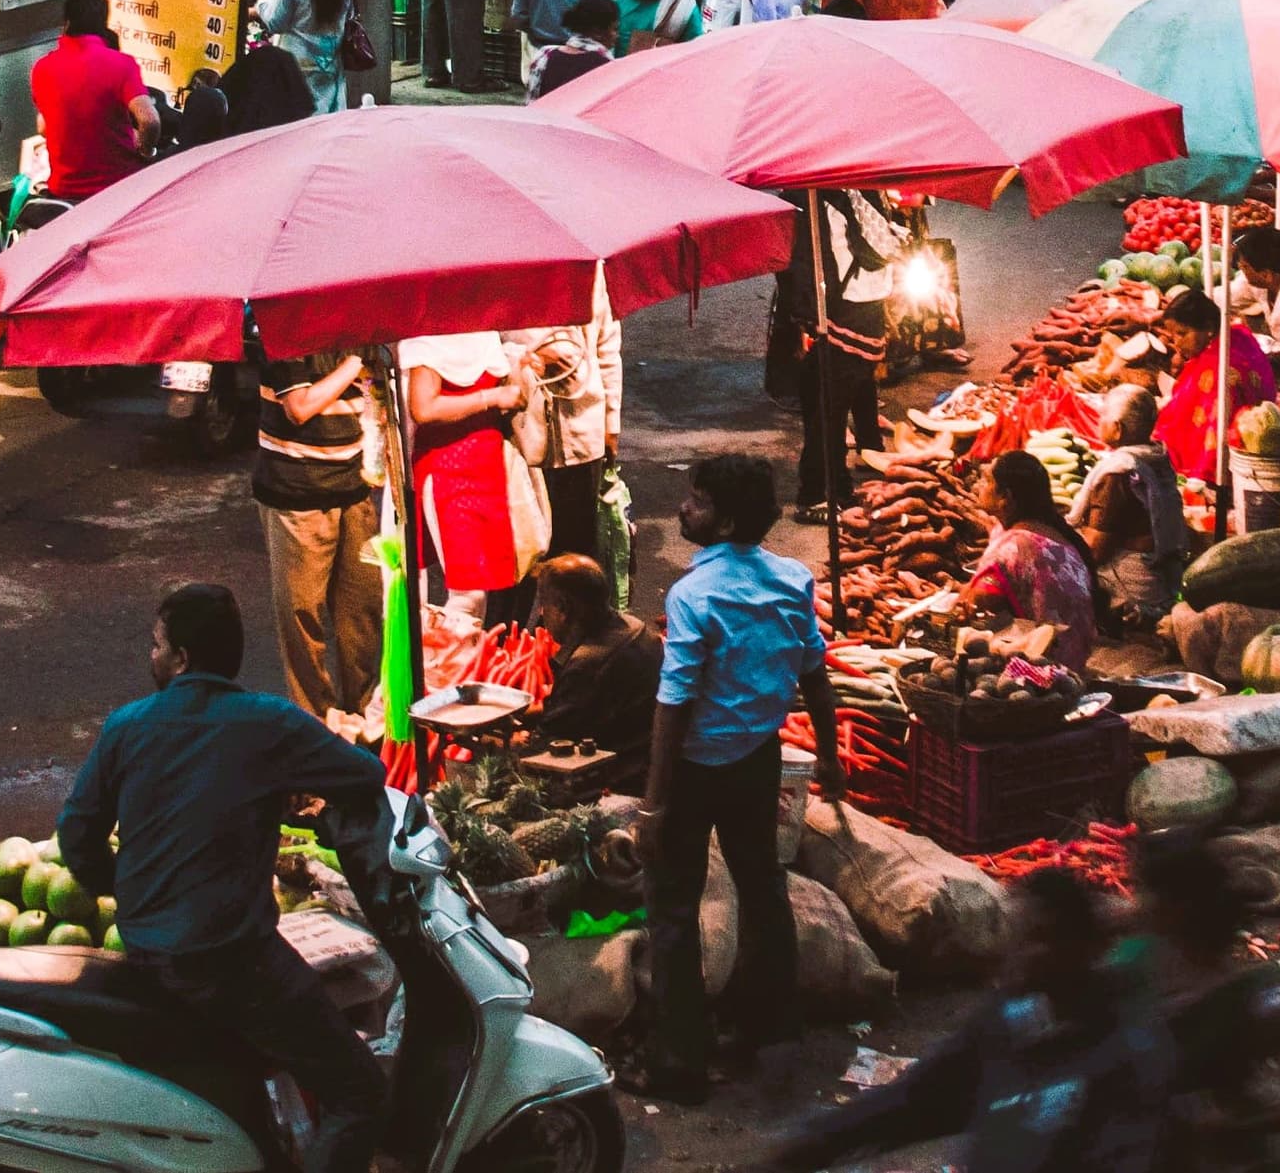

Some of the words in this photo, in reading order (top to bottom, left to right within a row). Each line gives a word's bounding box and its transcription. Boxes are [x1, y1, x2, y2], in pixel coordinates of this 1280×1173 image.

[115, 0, 159, 20] मस्तानी
[133, 29, 177, 51] मस्तानी
[139, 56, 171, 76] स्तानी
